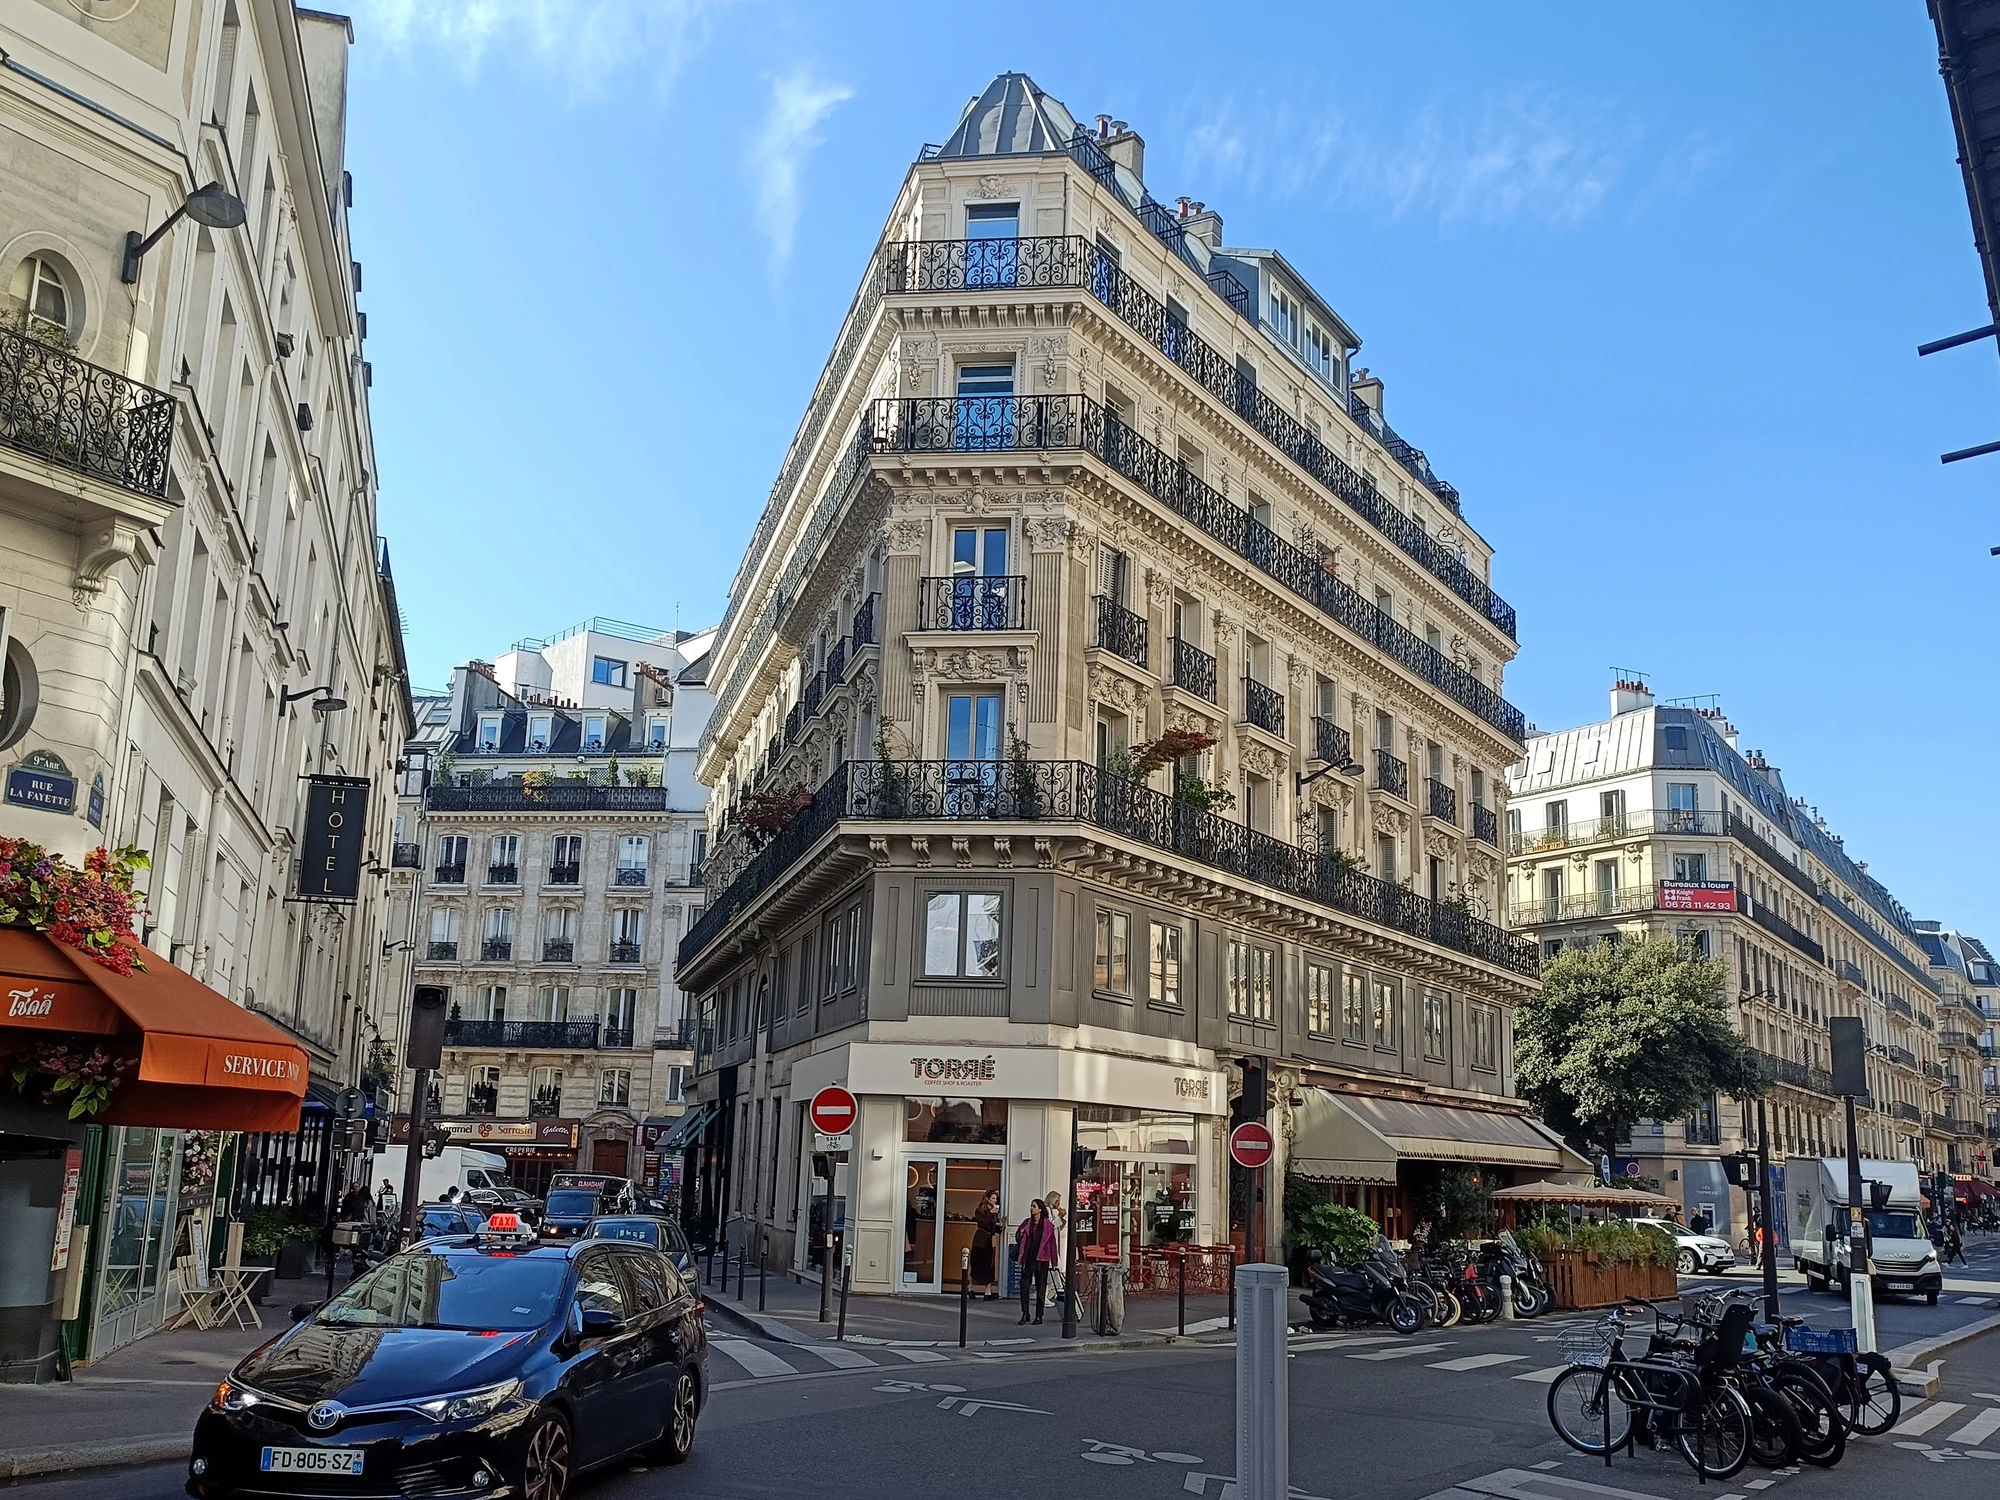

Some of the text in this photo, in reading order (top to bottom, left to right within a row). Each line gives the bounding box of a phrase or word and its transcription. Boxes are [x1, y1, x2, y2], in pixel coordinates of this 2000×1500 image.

[31, 780, 54, 792] RUE
[9, 787, 71, 807] LA FAYETTE
[323, 789, 346, 893] HÔTEL
[1718, 902, 1731, 910] 93
[223, 1054, 287, 1078] SERVICE
[498, 1126, 533, 1135] Sarrasin
[493, 1216, 515, 1227] TAXI
